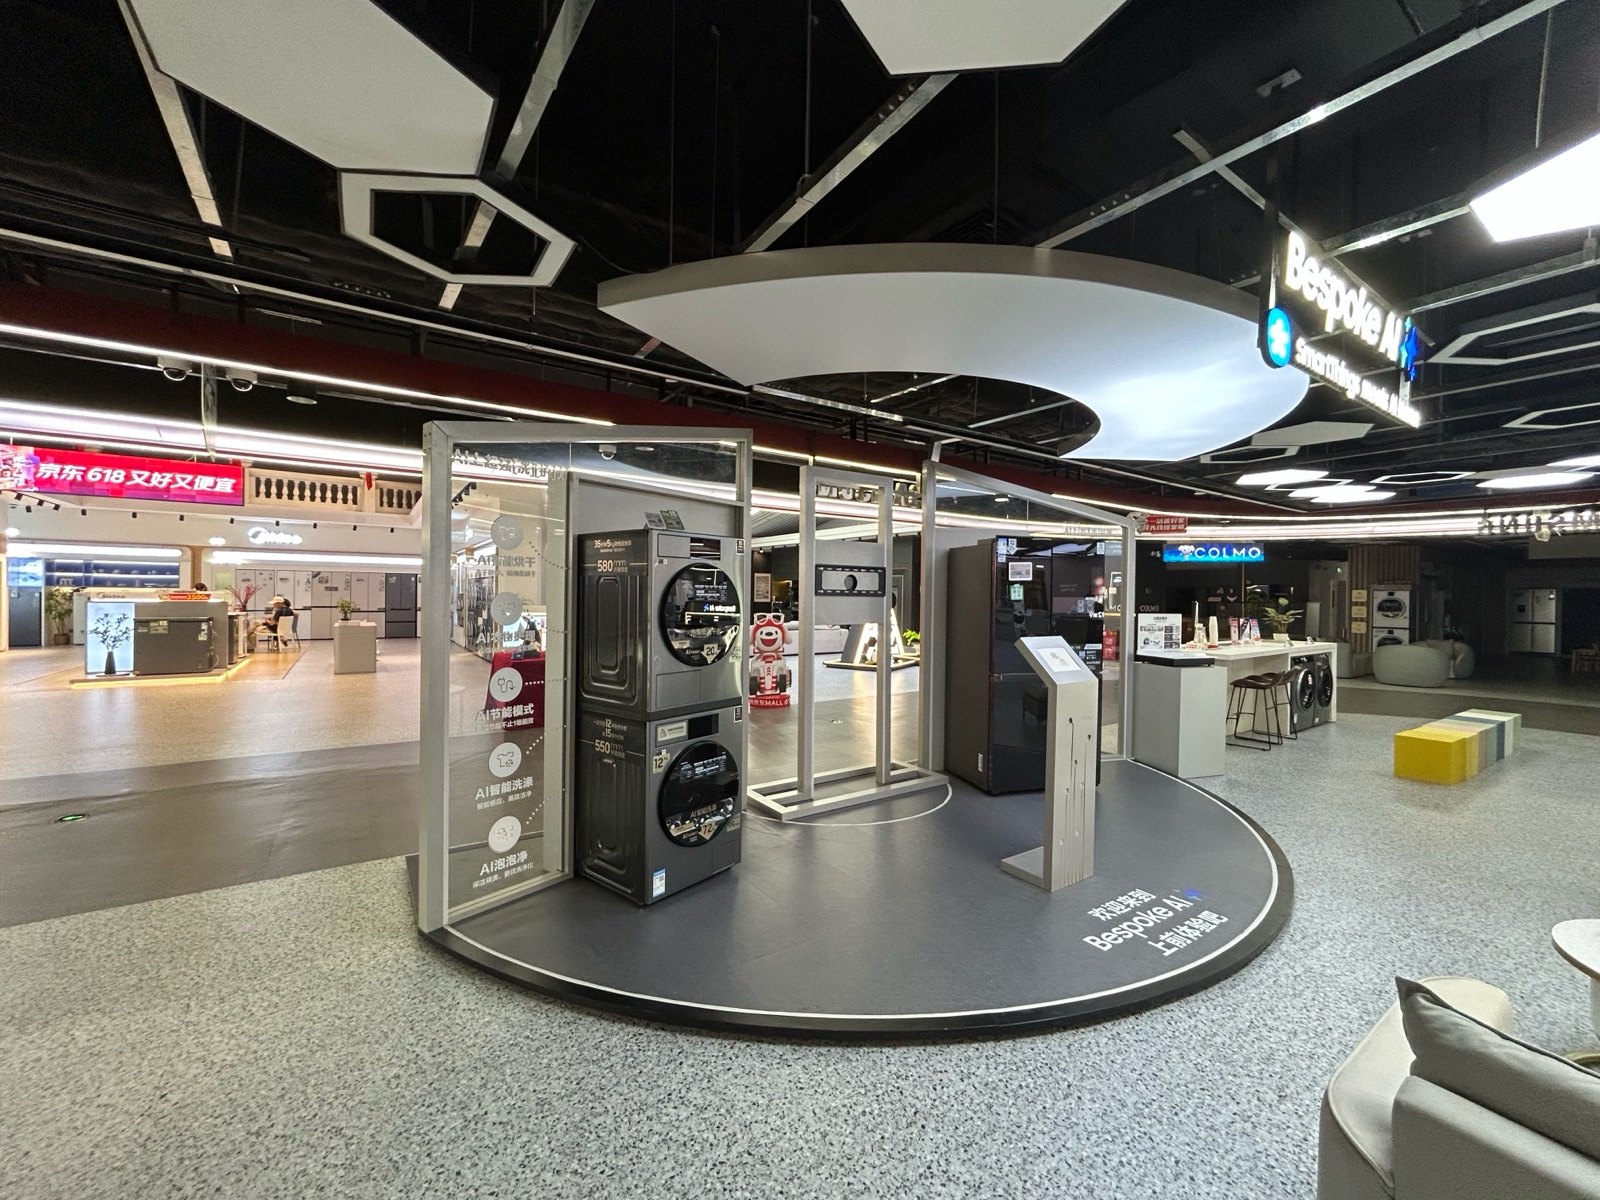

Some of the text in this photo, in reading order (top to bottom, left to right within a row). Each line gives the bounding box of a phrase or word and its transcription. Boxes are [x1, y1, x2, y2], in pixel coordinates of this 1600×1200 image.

[1285, 231, 1382, 346] Bespoke
[1194, 547, 1261, 559] COLMO
[475, 703, 534, 721] AI节能模式
[480, 850, 528, 876] AI泡泡净
[1087, 888, 1157, 922] 欢迎来到
[1082, 895, 1194, 952] Bespoke AI
